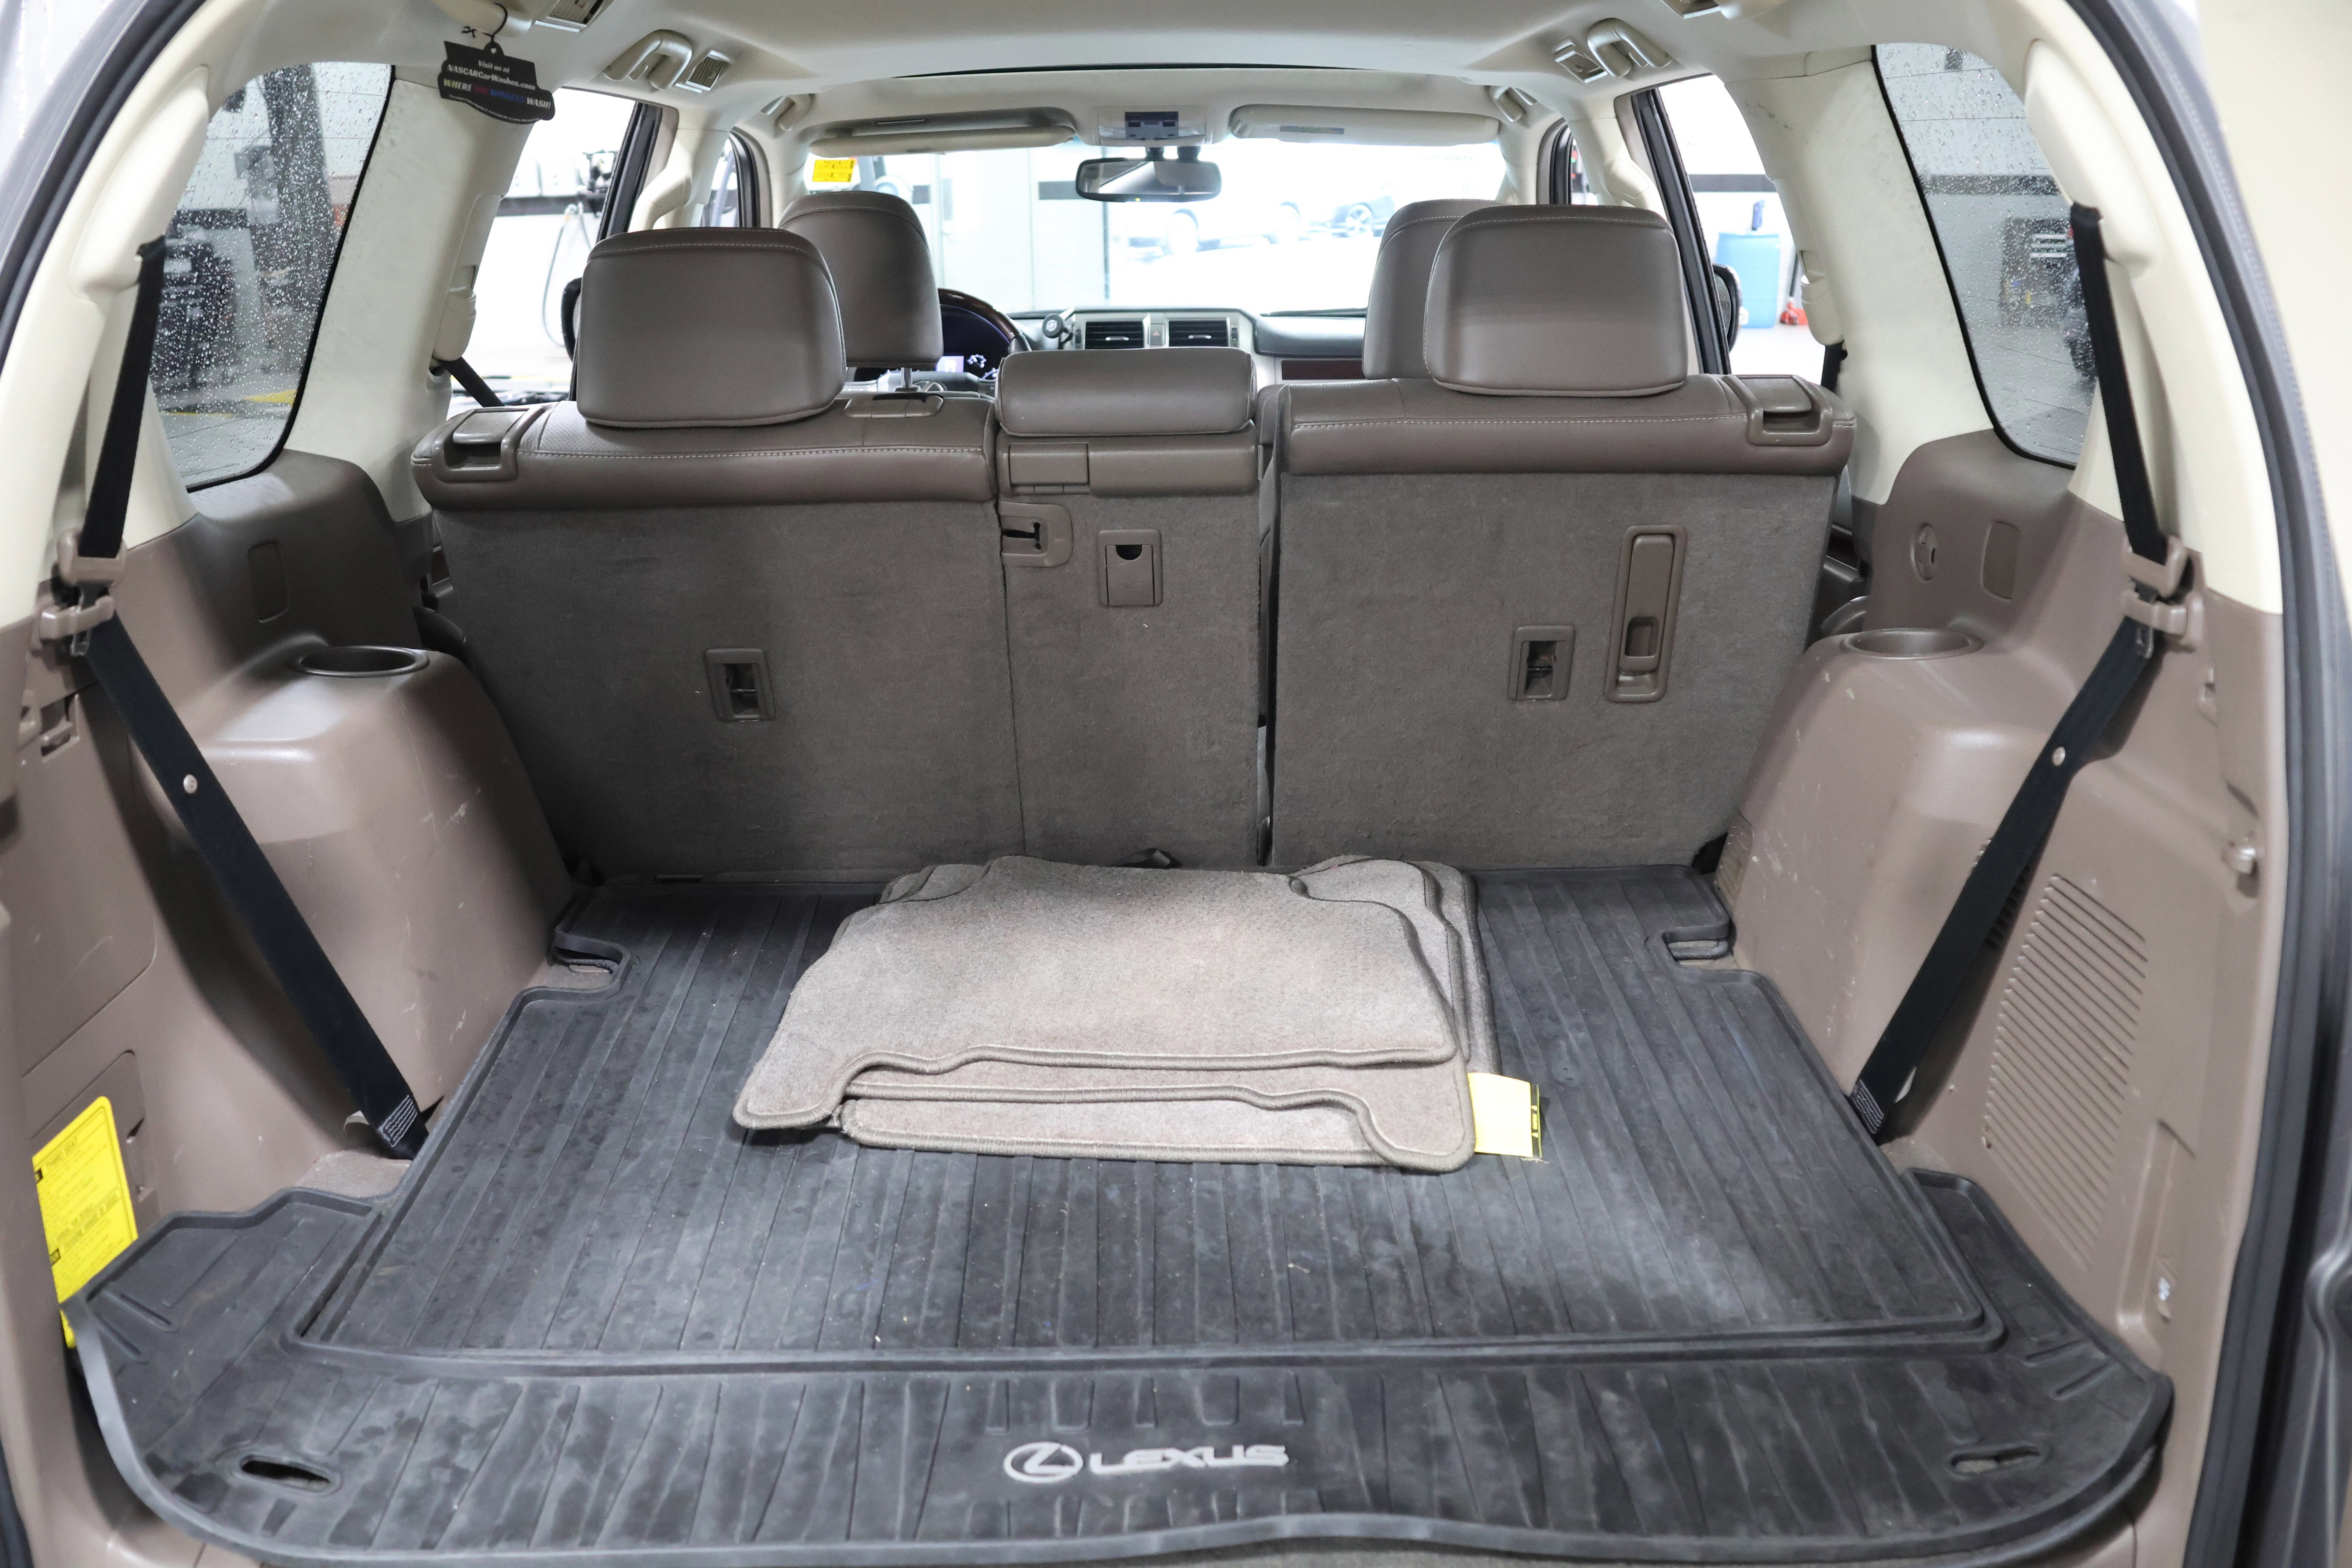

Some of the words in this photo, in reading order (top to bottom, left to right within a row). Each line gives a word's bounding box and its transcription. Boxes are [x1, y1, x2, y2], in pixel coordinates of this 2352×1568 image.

[447, 64, 536, 90] NASCARCarWashes.com
[478, 60, 493, 69] Visit
[444, 78, 472, 91] WHERE
[526, 97, 551, 109] WASH!
[1089, 1444, 1290, 1475] LEXUS
